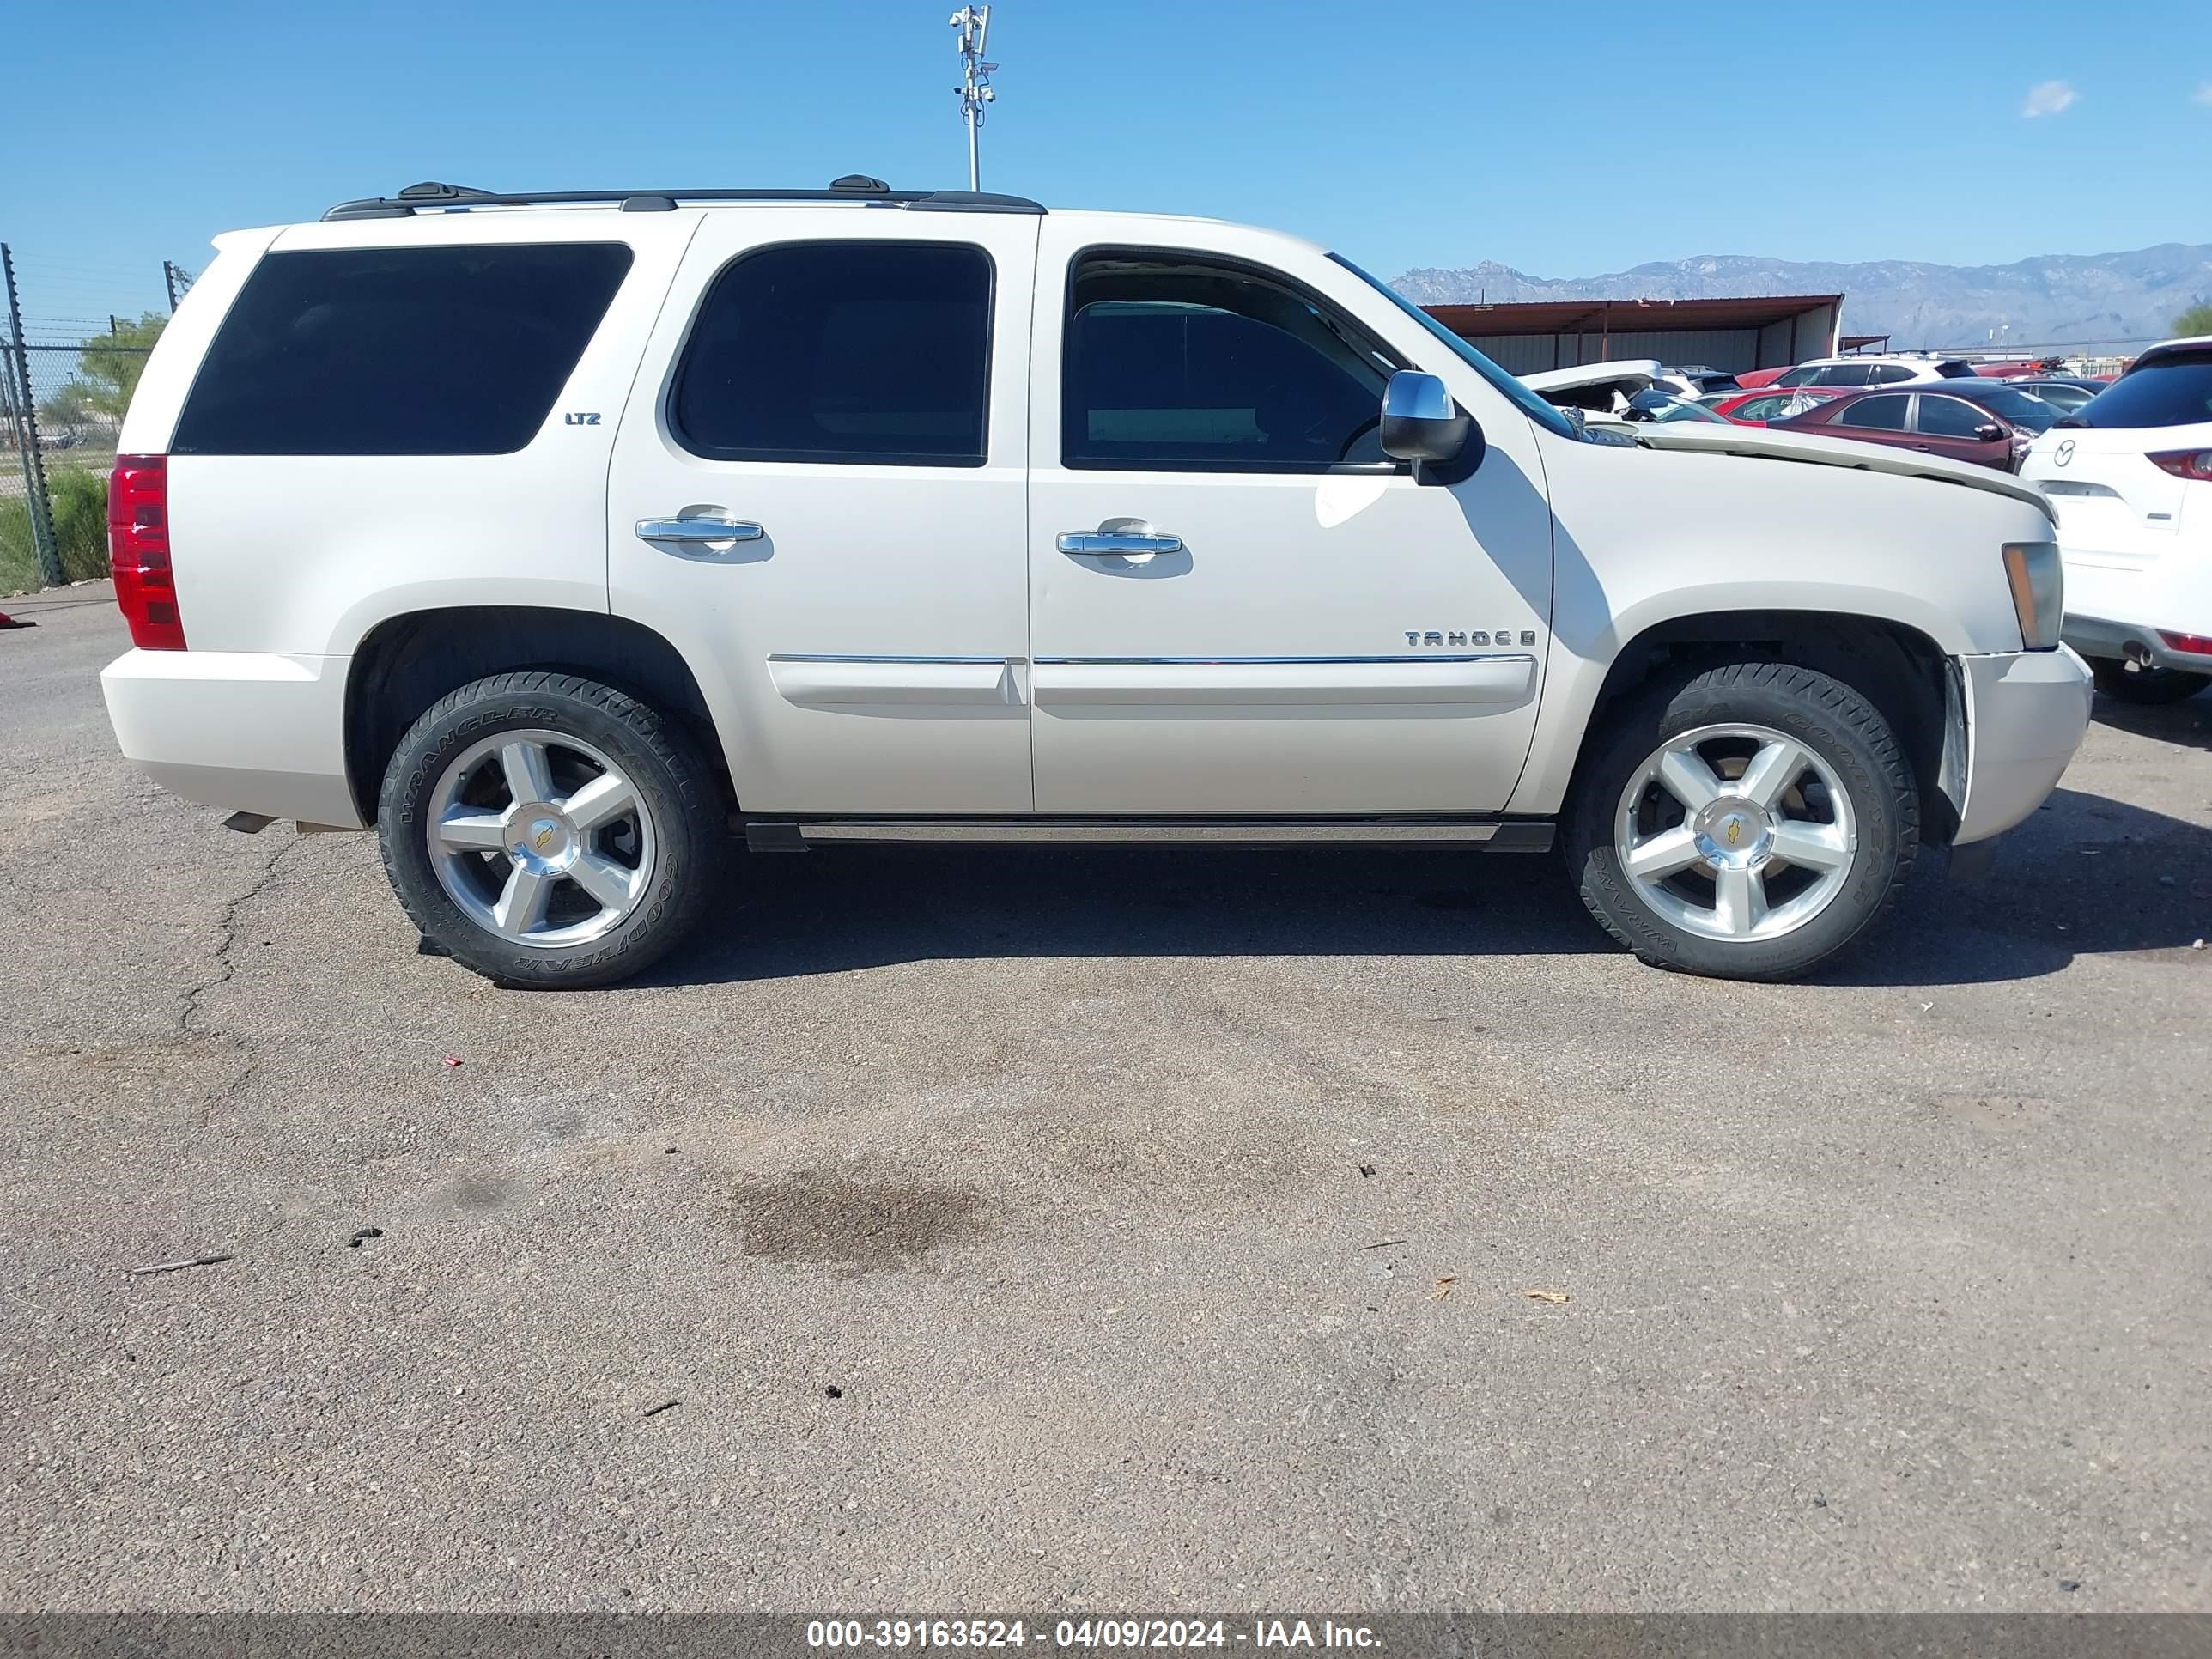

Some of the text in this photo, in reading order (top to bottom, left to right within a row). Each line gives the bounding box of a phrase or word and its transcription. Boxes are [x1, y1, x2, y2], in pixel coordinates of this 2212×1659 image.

[565, 412, 602, 426] LTZ
[1405, 630, 1512, 647] TAHOE
[400, 707, 559, 825] WRANGLER
[1784, 713, 1885, 907] GOODYEAR
[515, 853, 679, 972] GOODYEAR
